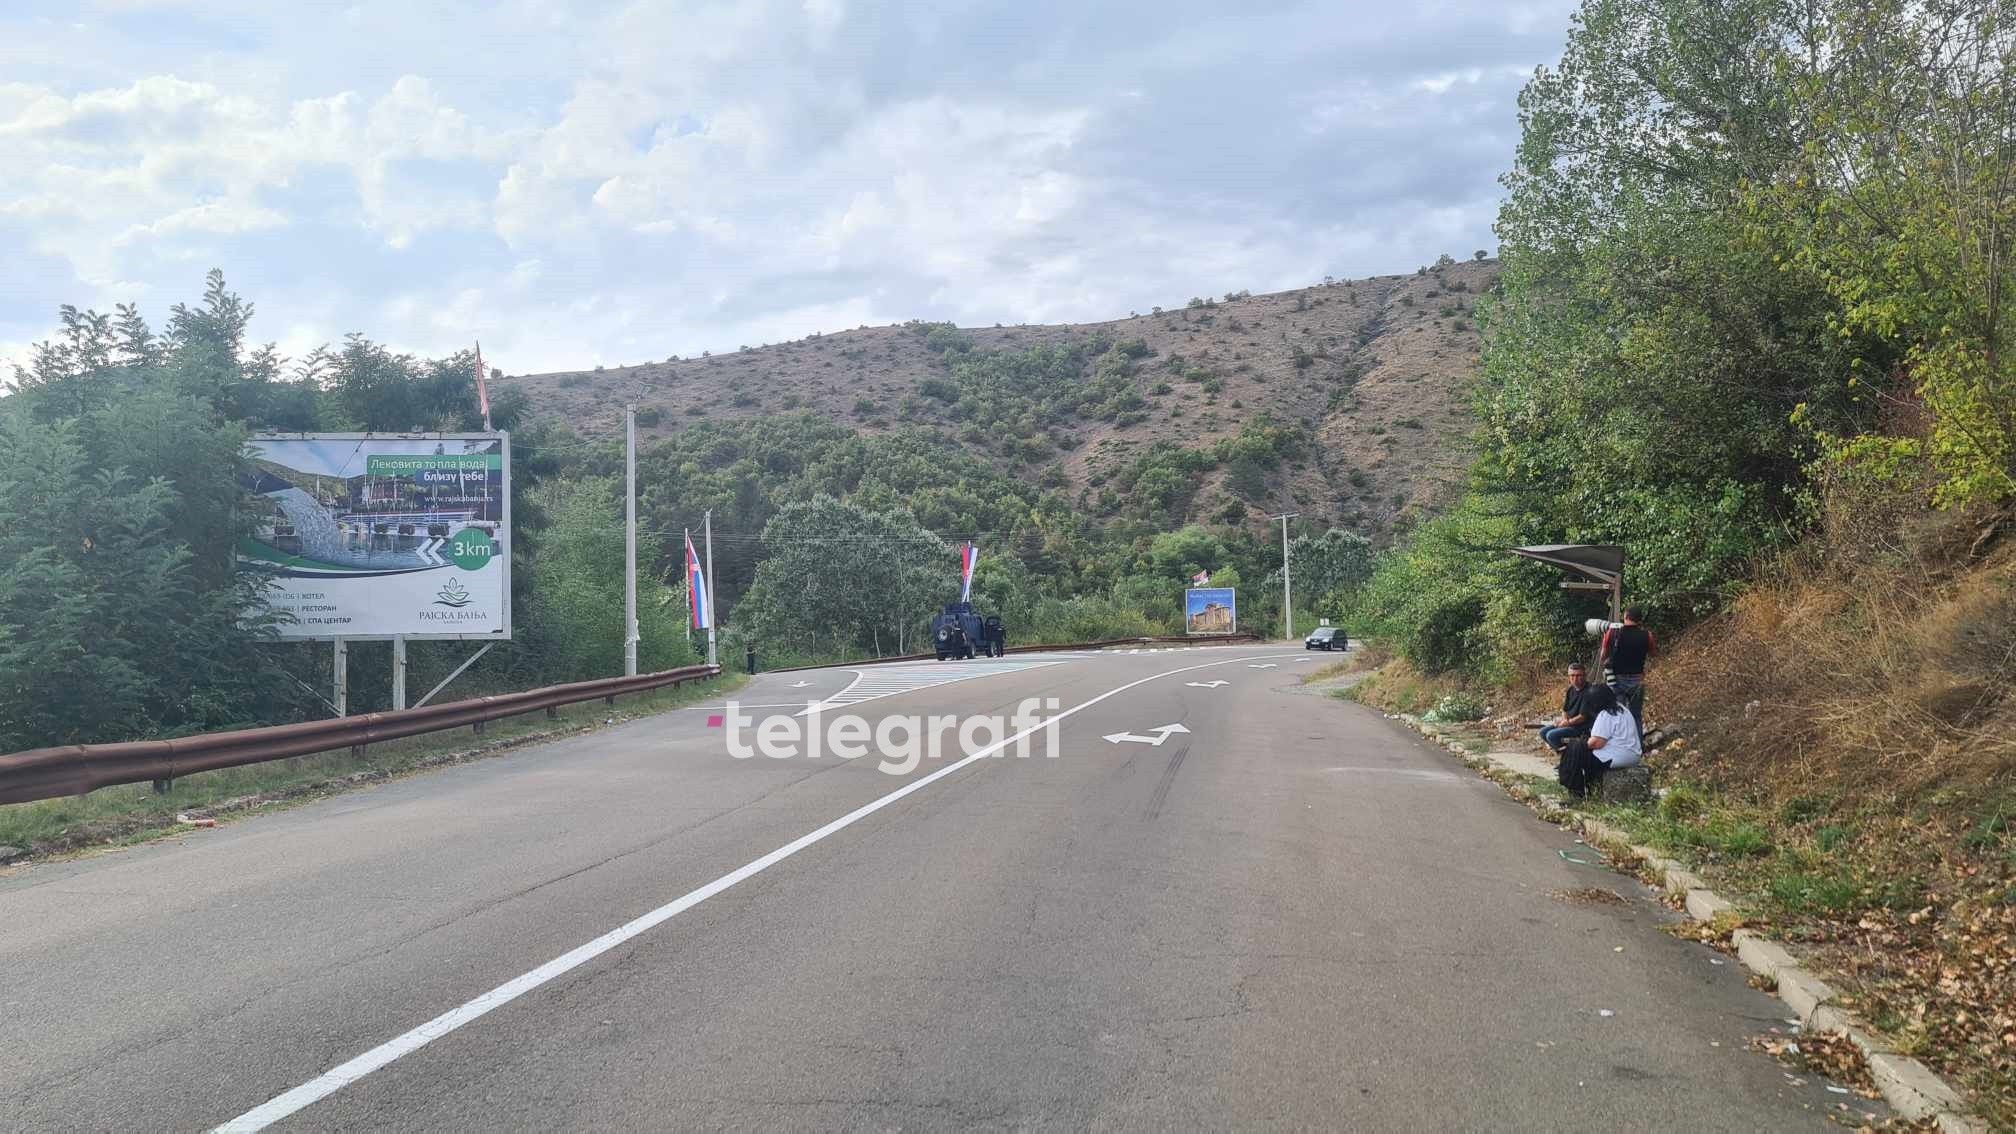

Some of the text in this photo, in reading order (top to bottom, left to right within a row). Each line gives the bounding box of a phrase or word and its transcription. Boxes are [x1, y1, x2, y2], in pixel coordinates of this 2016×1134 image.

[371, 459, 422, 470] Лековита
[425, 461, 456, 469] топла
[423, 471, 484, 483] близу тебе
[454, 541, 490, 556] 3 km
[419, 611, 487, 621] РАЈСКА БАЊА
